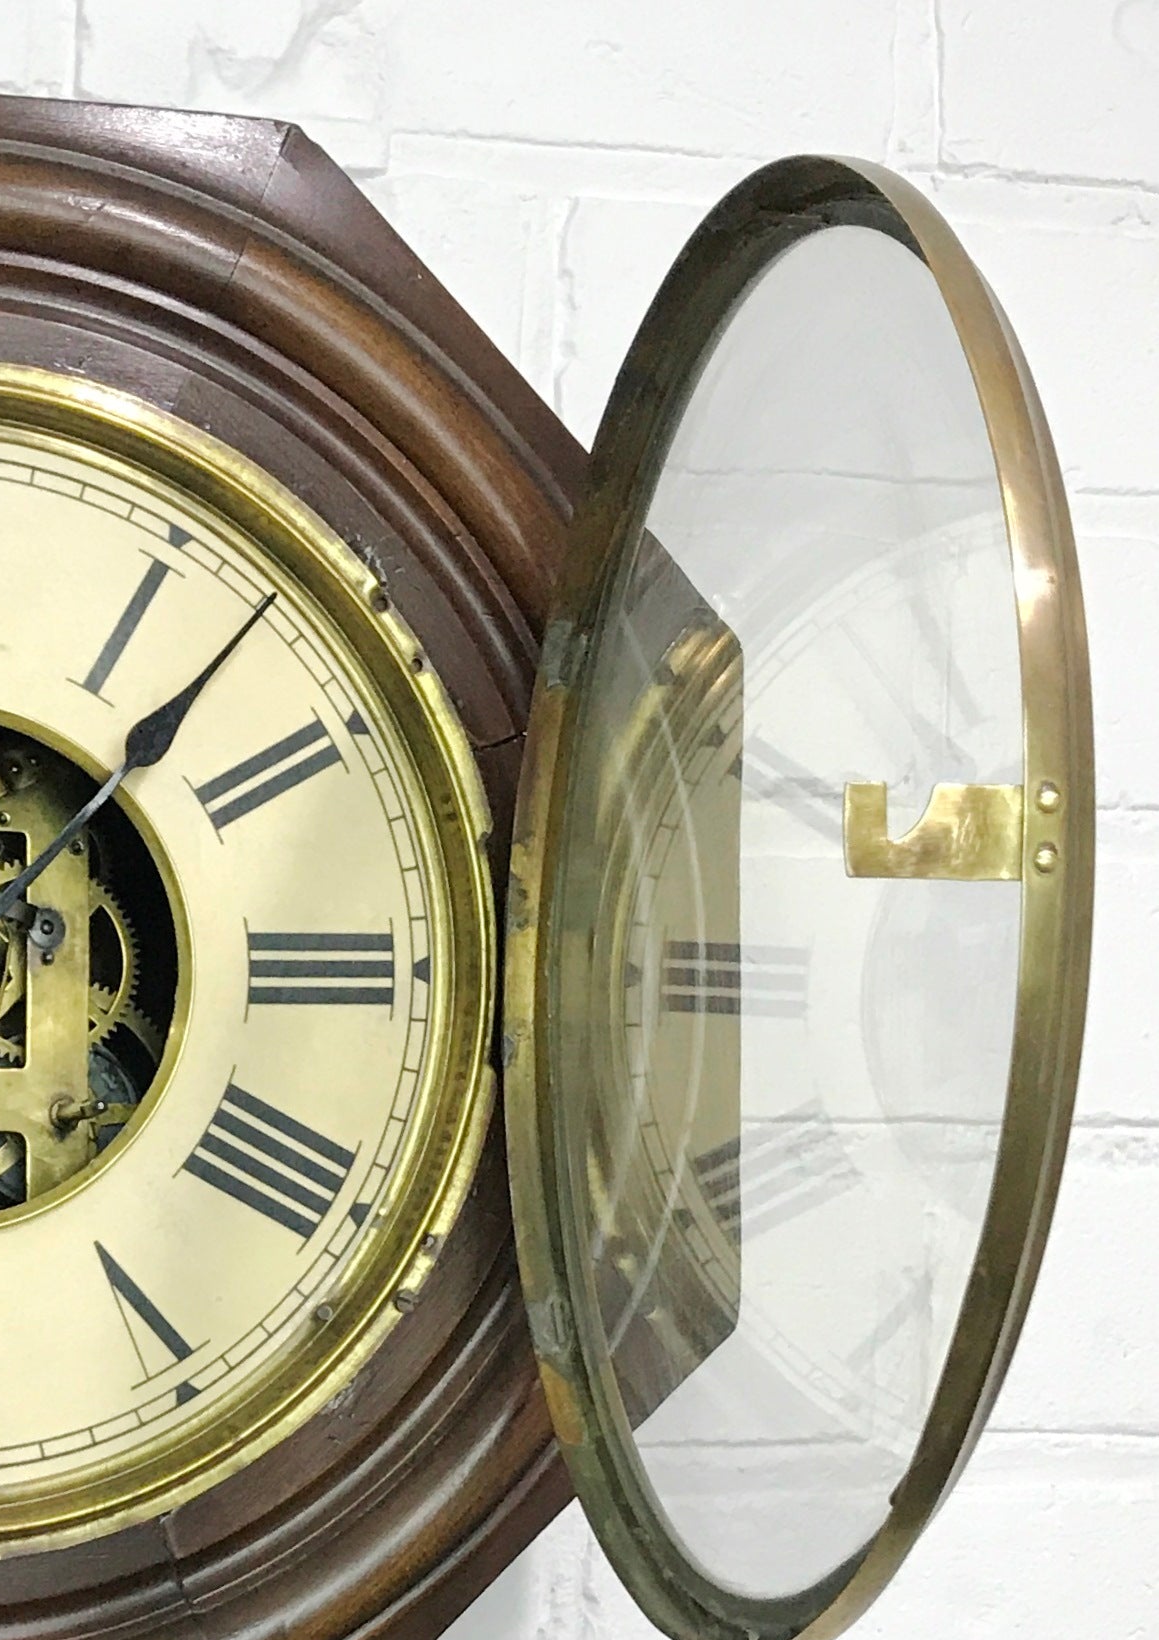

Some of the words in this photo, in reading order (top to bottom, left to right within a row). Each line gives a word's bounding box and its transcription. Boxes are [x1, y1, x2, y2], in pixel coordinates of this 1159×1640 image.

[66, 548, 185, 709] I
[182, 708, 349, 844] II
[244, 917, 395, 1022] III
[172, 1066, 363, 1254] IIII
[93, 1241, 208, 1391] V
